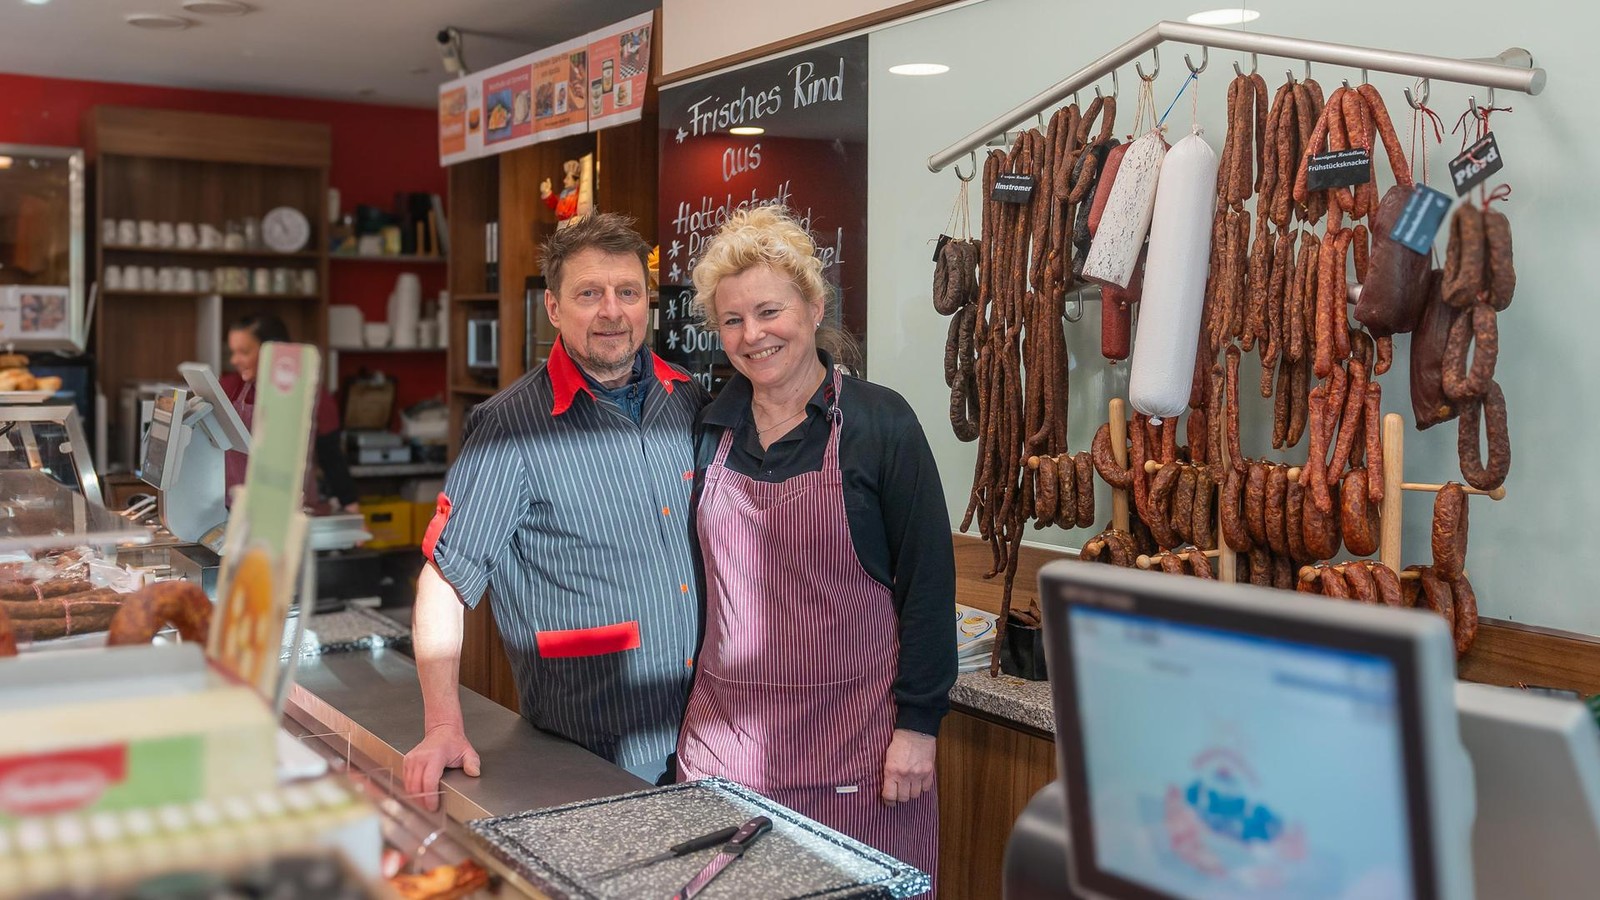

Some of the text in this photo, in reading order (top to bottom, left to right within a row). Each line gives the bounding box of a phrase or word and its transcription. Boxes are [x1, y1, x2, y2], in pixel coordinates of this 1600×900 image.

[687, 57, 844, 137] Frisches Rind
[722, 143, 761, 182] aus
[1308, 158, 1369, 172] Frühstücksknacker
[995, 182, 1033, 192] Ilmstromer
[672, 179, 793, 235] Hottelstdt
